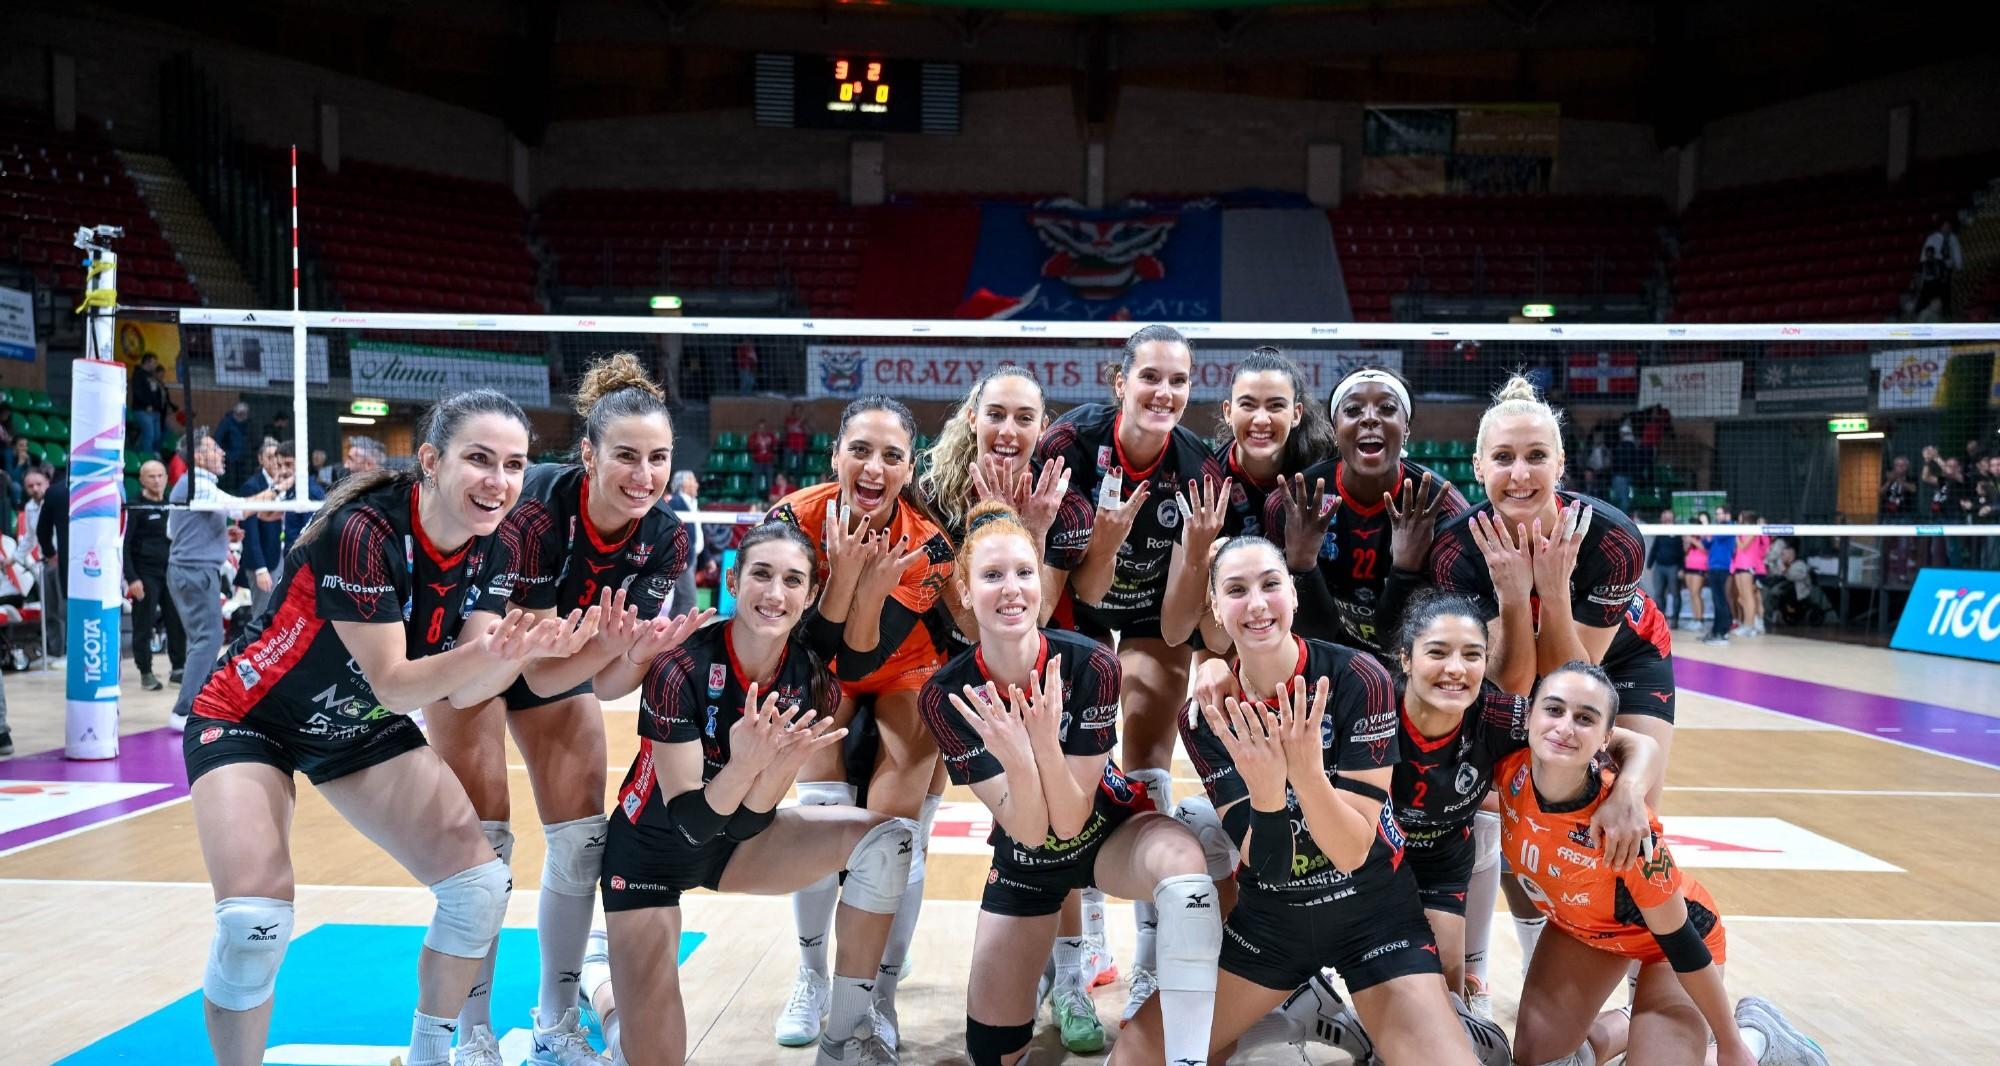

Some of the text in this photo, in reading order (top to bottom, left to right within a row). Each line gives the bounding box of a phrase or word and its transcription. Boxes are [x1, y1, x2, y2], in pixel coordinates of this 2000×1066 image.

[835, 61, 880, 81] 3 2
[840, 83, 853, 101] 0
[876, 85, 889, 103] 0
[874, 357, 982, 387] CRAZY
[1352, 547, 1377, 579] 22
[578, 579, 598, 605] 3
[426, 606, 445, 644] 8
[1411, 781, 1428, 808] 2
[1519, 839, 1540, 874] 10
